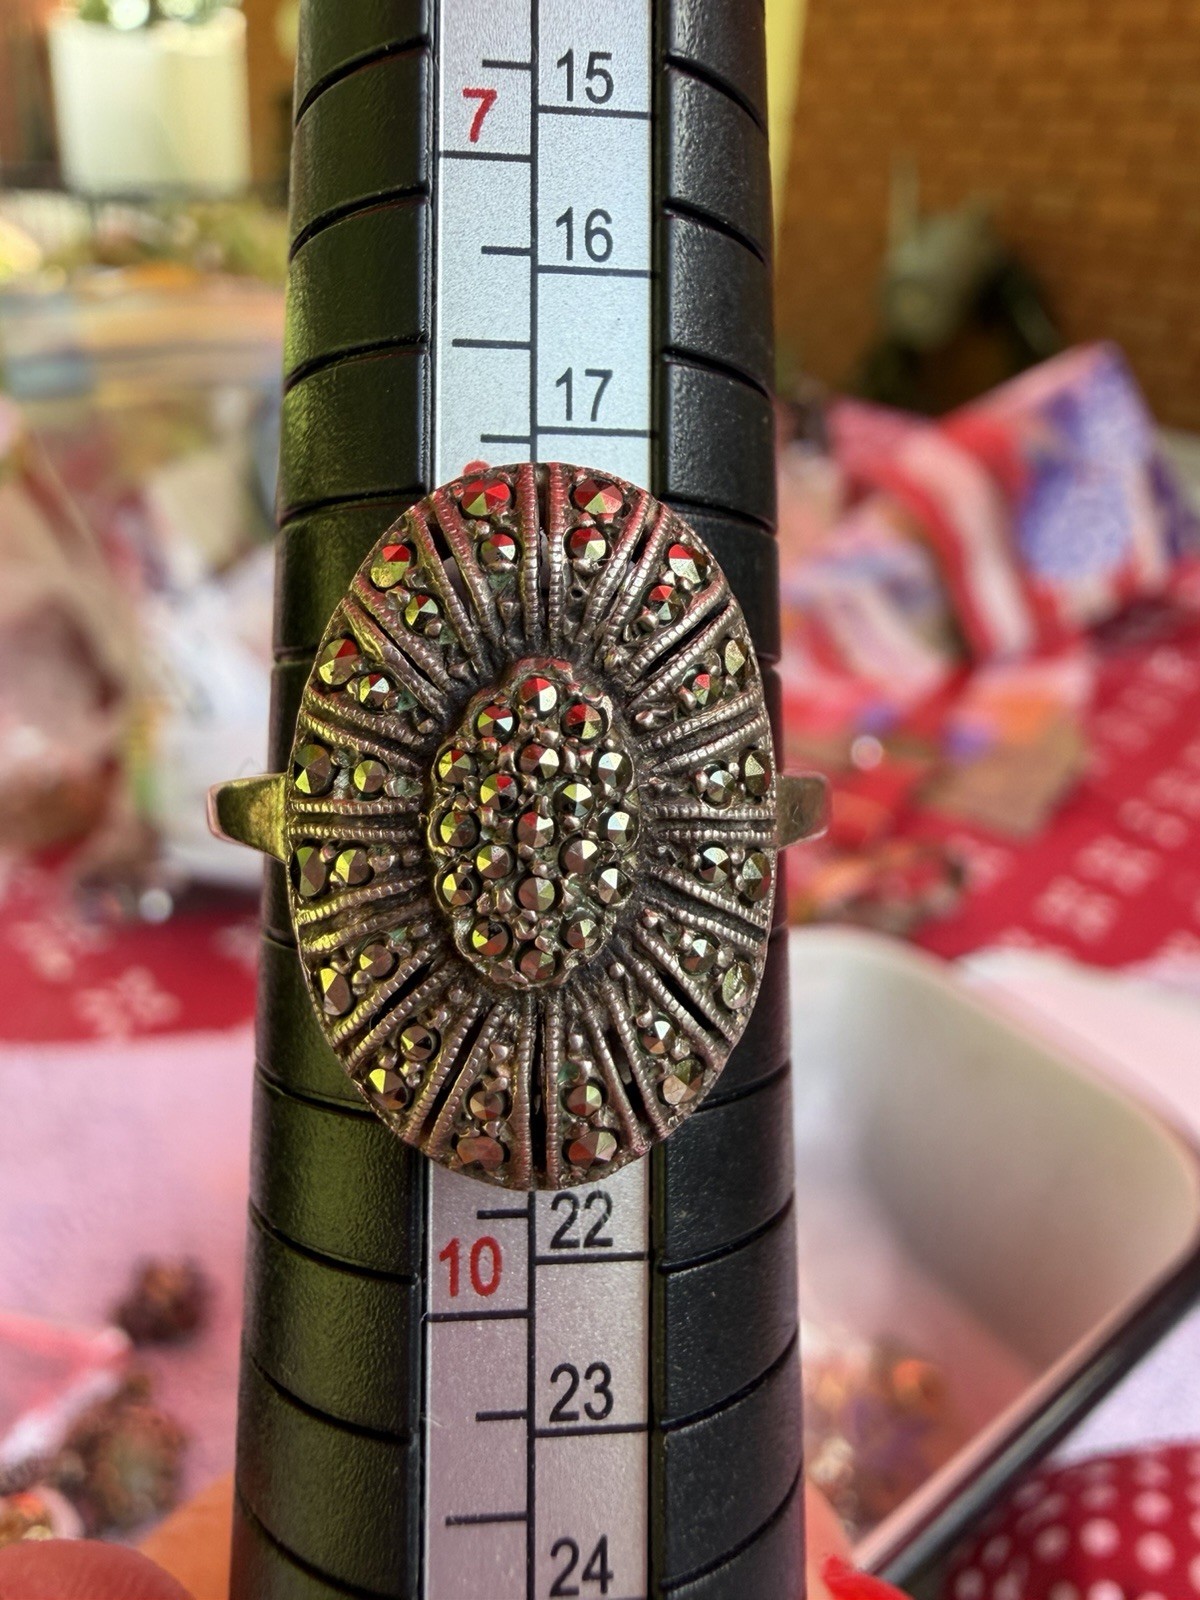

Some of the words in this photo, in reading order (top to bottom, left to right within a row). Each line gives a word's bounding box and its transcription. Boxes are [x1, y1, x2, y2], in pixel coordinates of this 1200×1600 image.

[556, 49, 614, 104] 15
[463, 88, 497, 142] 7
[556, 207, 613, 263] 16
[556, 367, 613, 422] 17
[550, 1191, 613, 1249] 22
[439, 1236, 502, 1297] 10
[549, 1362, 613, 1422] 23
[550, 1534, 613, 1597] 24
